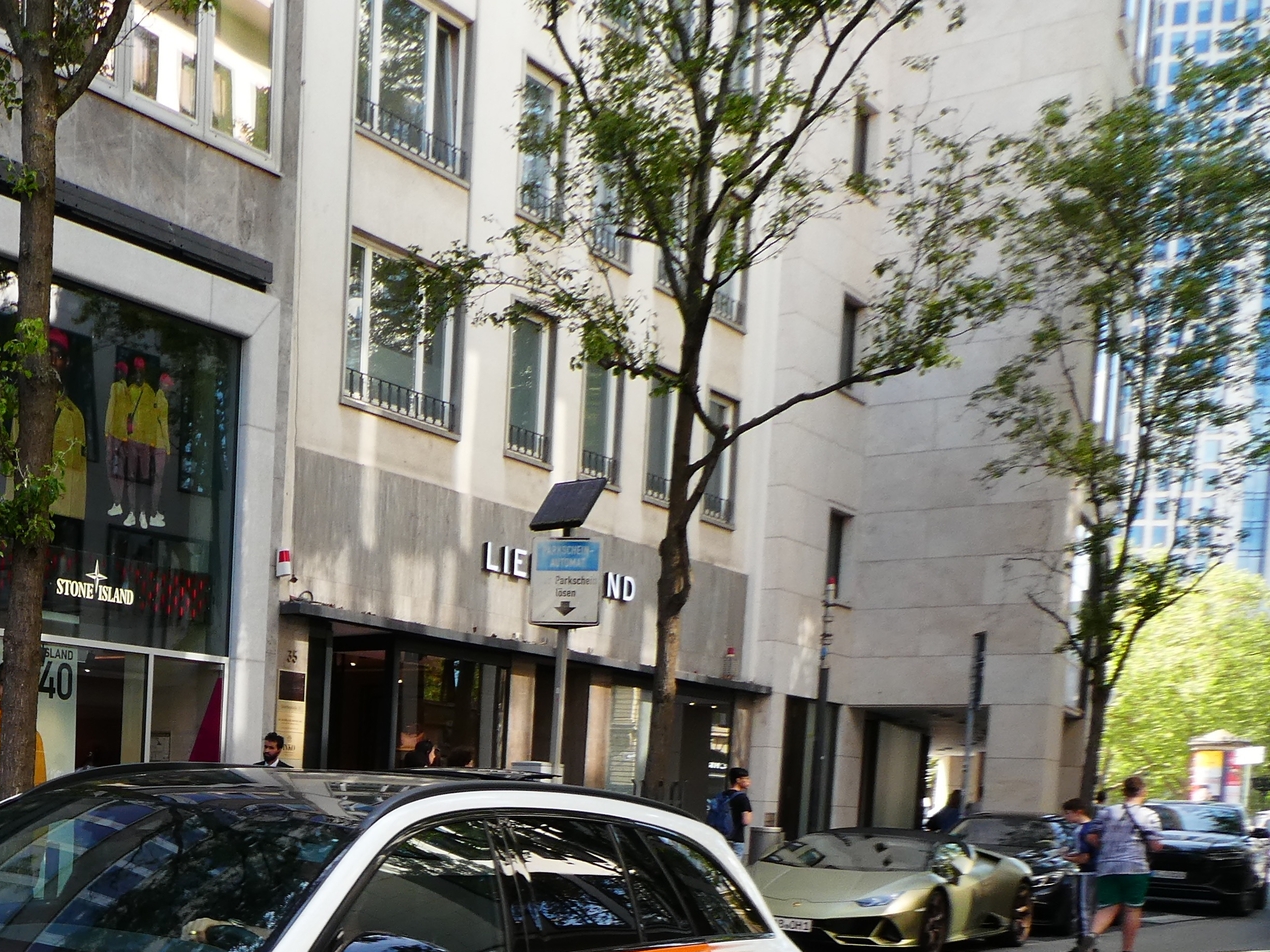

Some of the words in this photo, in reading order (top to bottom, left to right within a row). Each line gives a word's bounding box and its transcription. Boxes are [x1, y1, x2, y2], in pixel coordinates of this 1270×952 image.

[56, 578, 94, 599] STONE
[98, 585, 135, 605] ISLAND
[555, 587, 576, 597] lösen
[44, 648, 74, 660] SLAND
